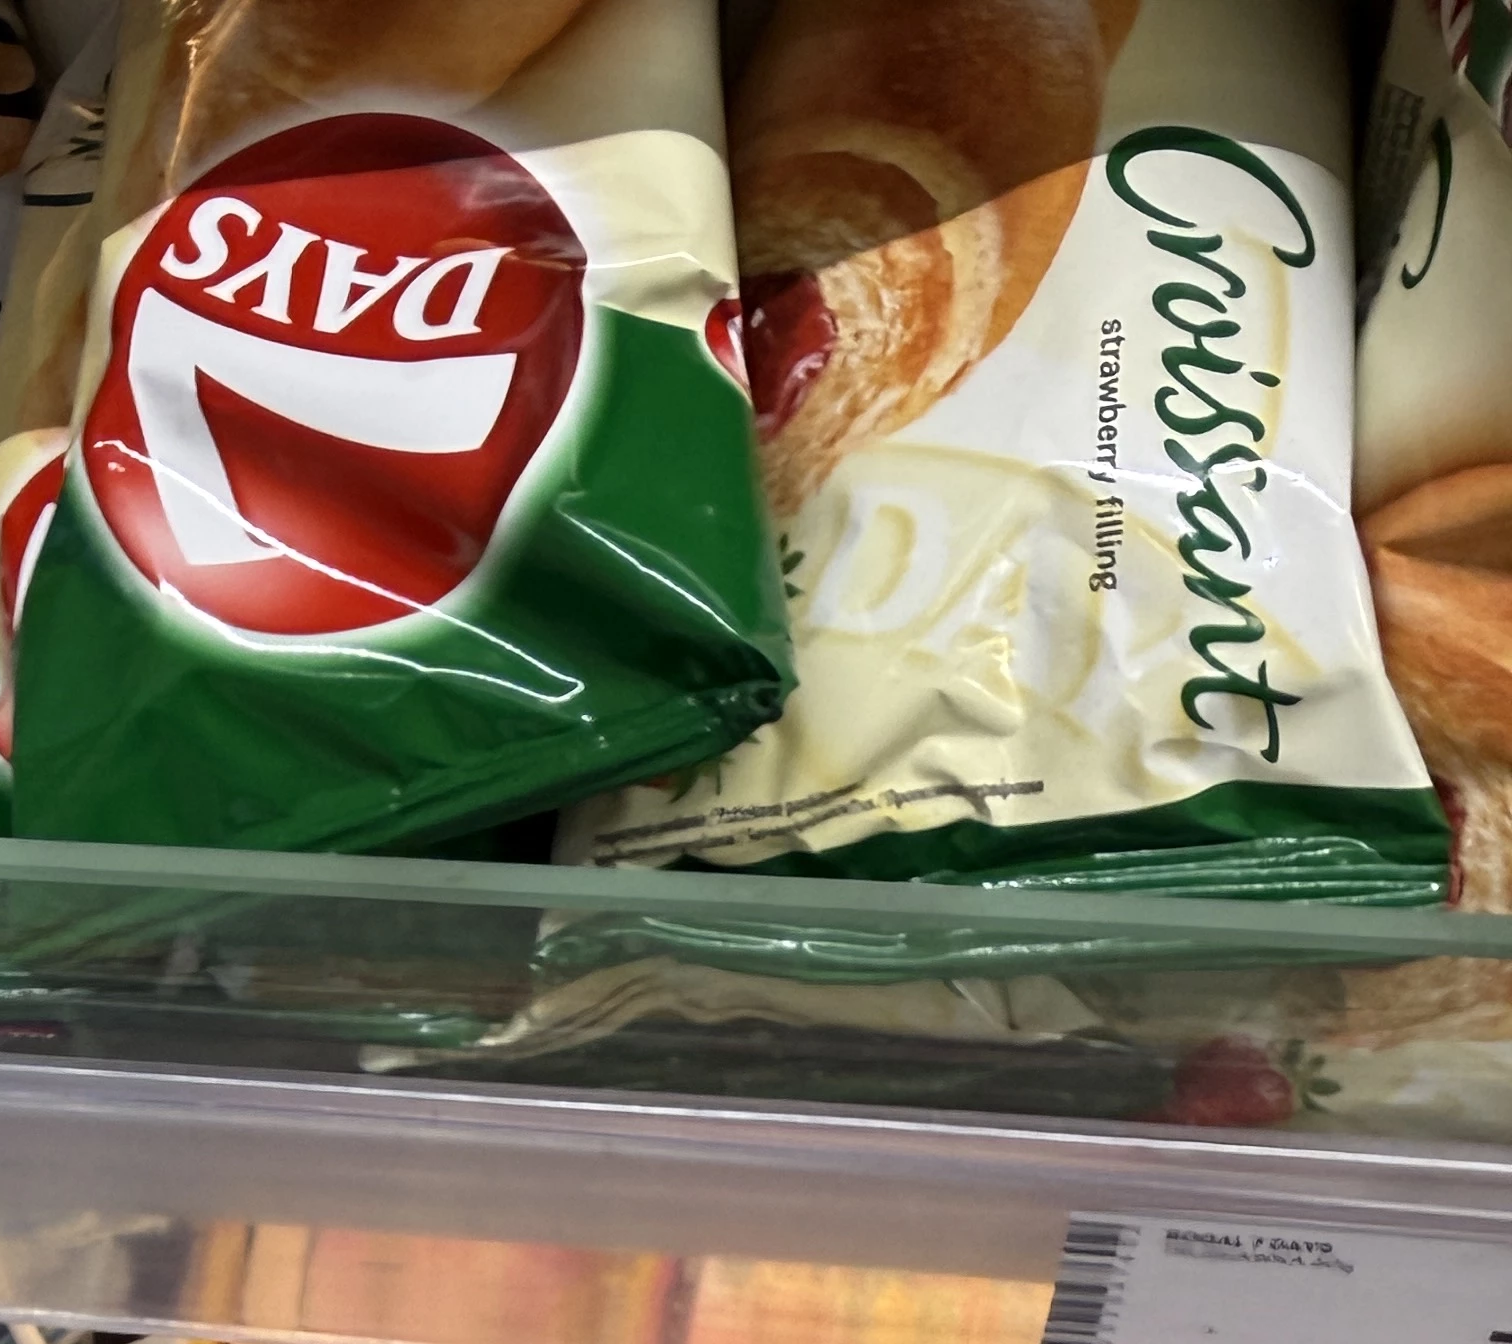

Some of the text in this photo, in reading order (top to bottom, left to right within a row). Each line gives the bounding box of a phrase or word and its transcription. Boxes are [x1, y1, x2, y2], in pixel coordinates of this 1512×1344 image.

[159, 195, 516, 342] DAYS
[128, 285, 518, 566] 7
[1088, 318, 1127, 593] strawberry filling
[1104, 125, 1317, 764] Croissant
